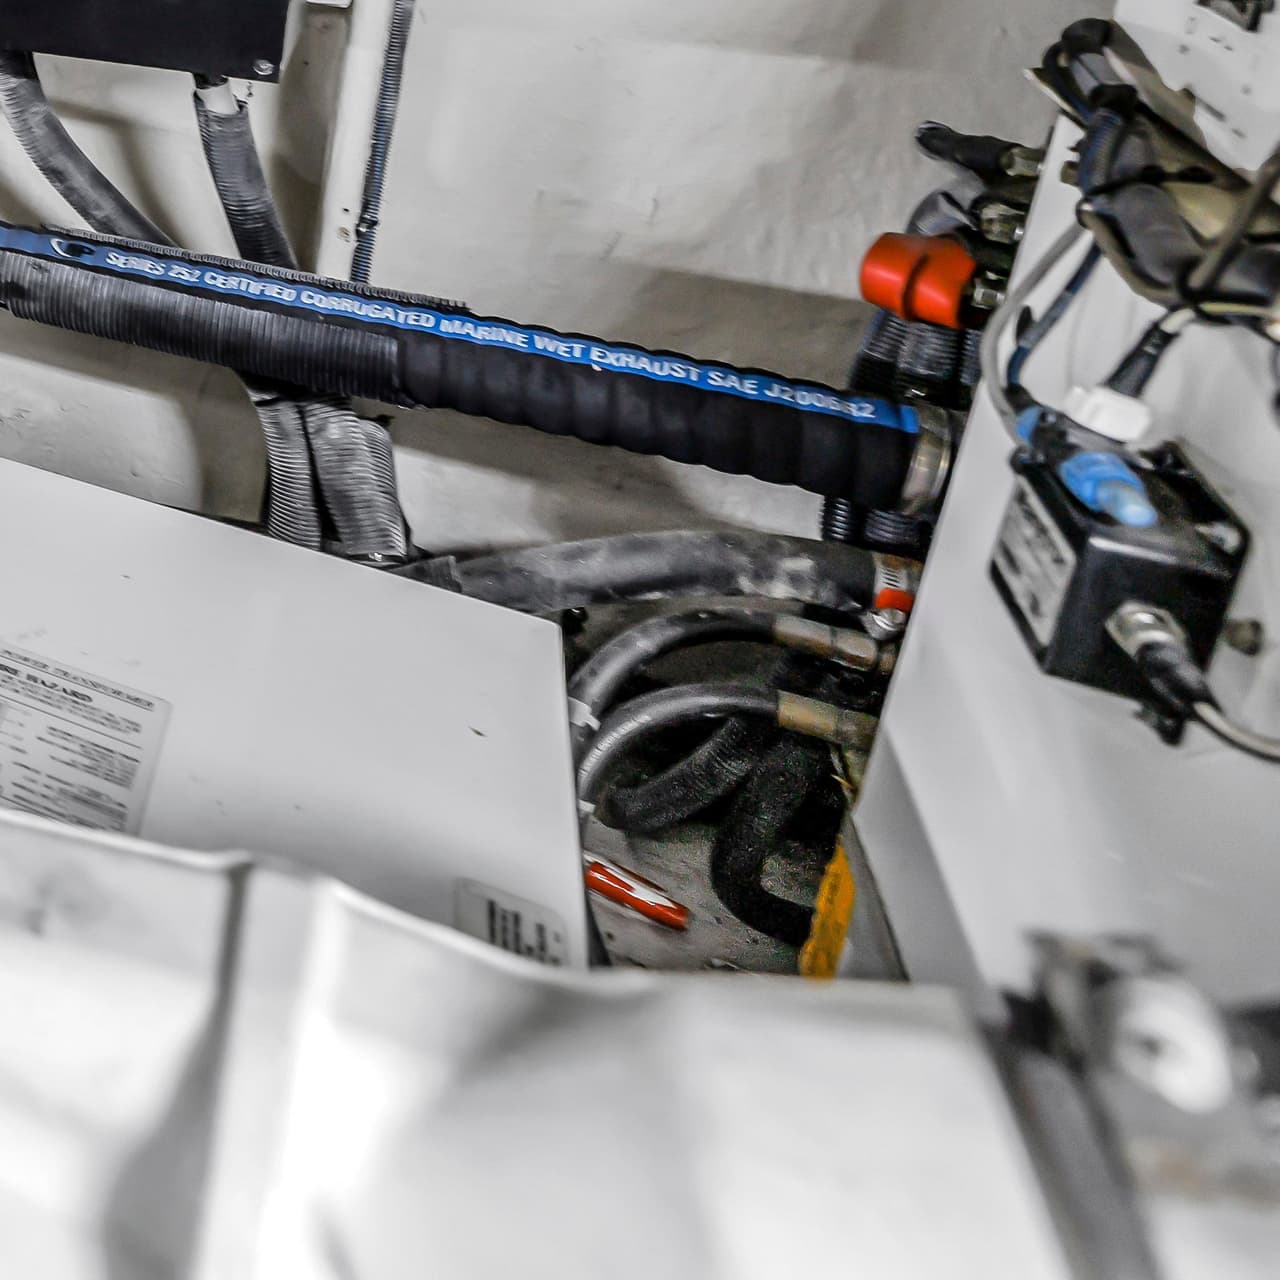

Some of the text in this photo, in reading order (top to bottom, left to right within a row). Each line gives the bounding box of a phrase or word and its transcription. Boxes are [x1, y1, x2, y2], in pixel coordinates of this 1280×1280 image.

[105, 251, 165, 276] SERIES
[167, 263, 202, 282] 252
[204, 271, 298, 302] CERTIFIED
[300, 290, 435, 328] CORRUGATED
[440, 319, 529, 348] MARINE
[533, 334, 586, 358] WET
[591, 348, 702, 382] EXHAUST
[706, 370, 759, 395] SAE
